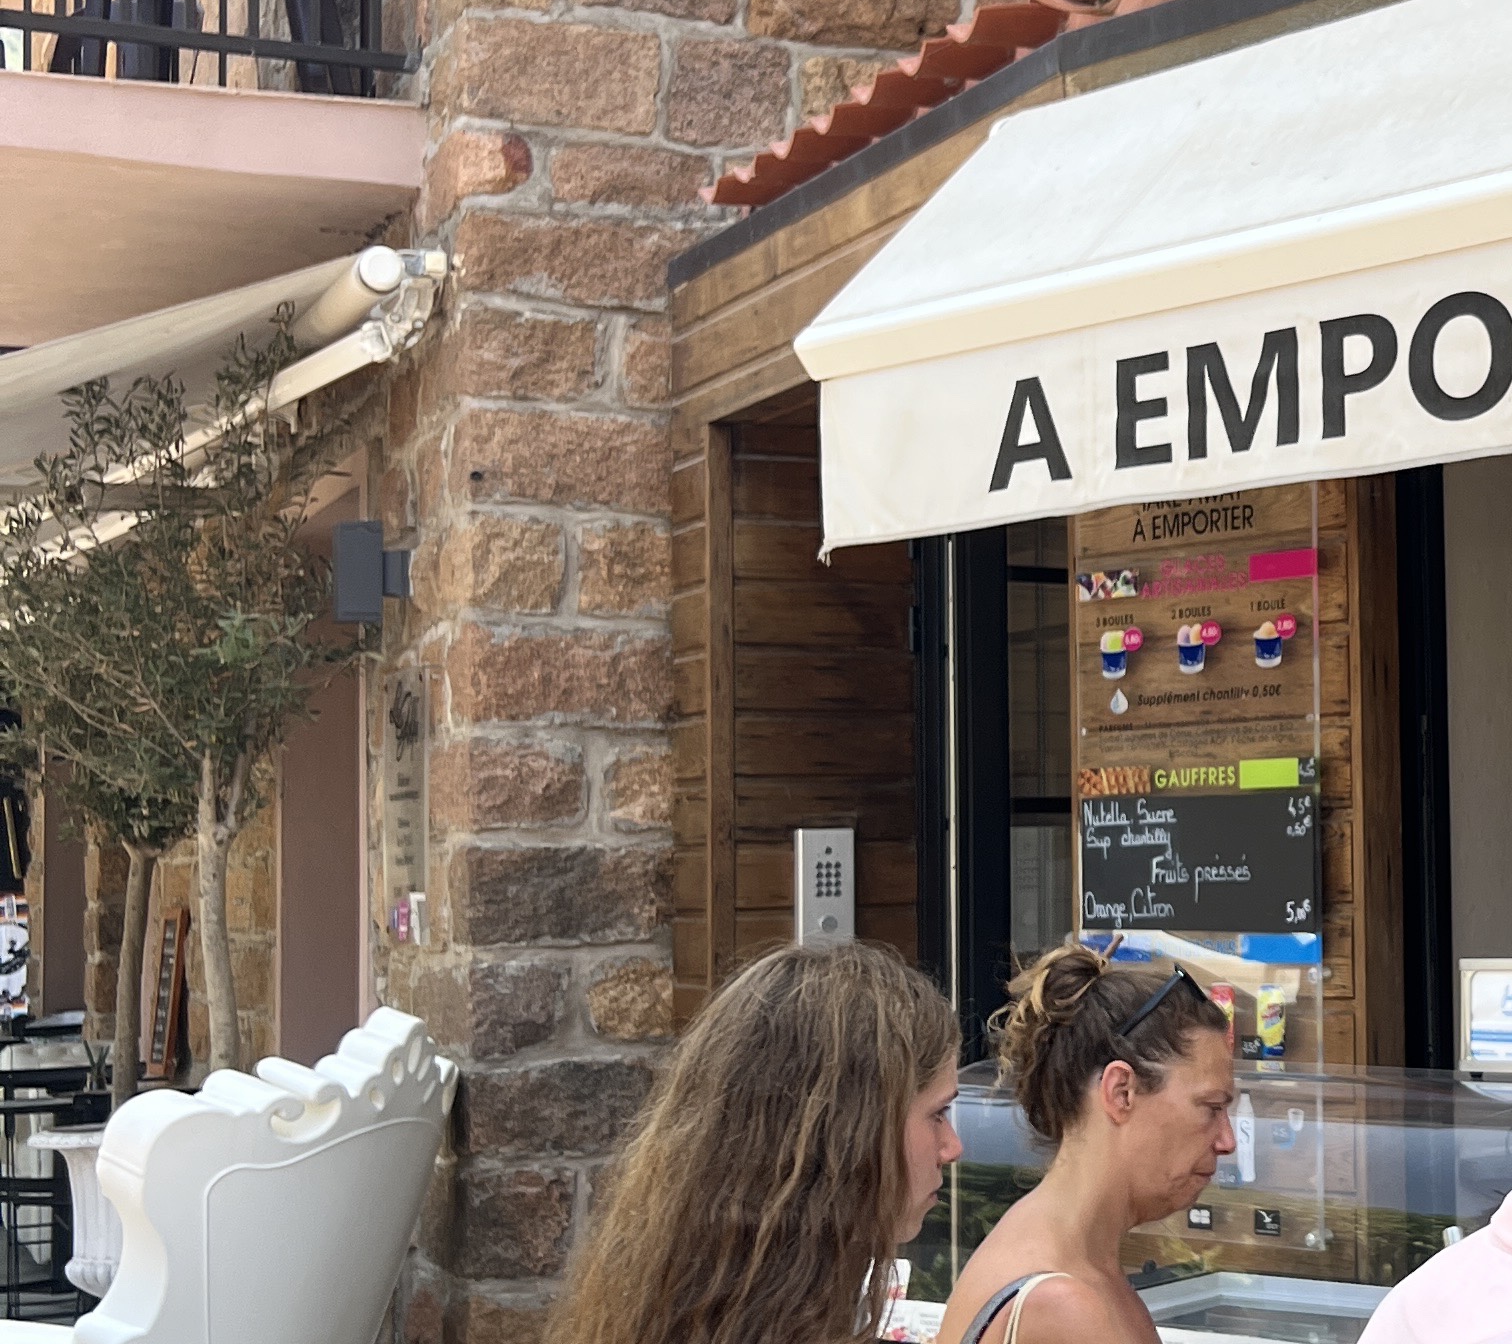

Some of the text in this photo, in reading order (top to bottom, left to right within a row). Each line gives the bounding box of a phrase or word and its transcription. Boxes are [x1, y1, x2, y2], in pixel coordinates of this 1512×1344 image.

[989, 376, 1072, 492] A
[1152, 504, 1253, 540] EMPORTER
[1179, 605, 1211, 619] BOULES
[1257, 599, 1286, 611] BOULE
[1103, 614, 1134, 627] BOULES
[1137, 690, 1199, 707] Supplément
[1155, 766, 1236, 788] GAUFFRES
[1137, 798, 1177, 824] Sucre
[1086, 827, 1111, 860] Sup
[1152, 853, 1190, 884] Fruits
